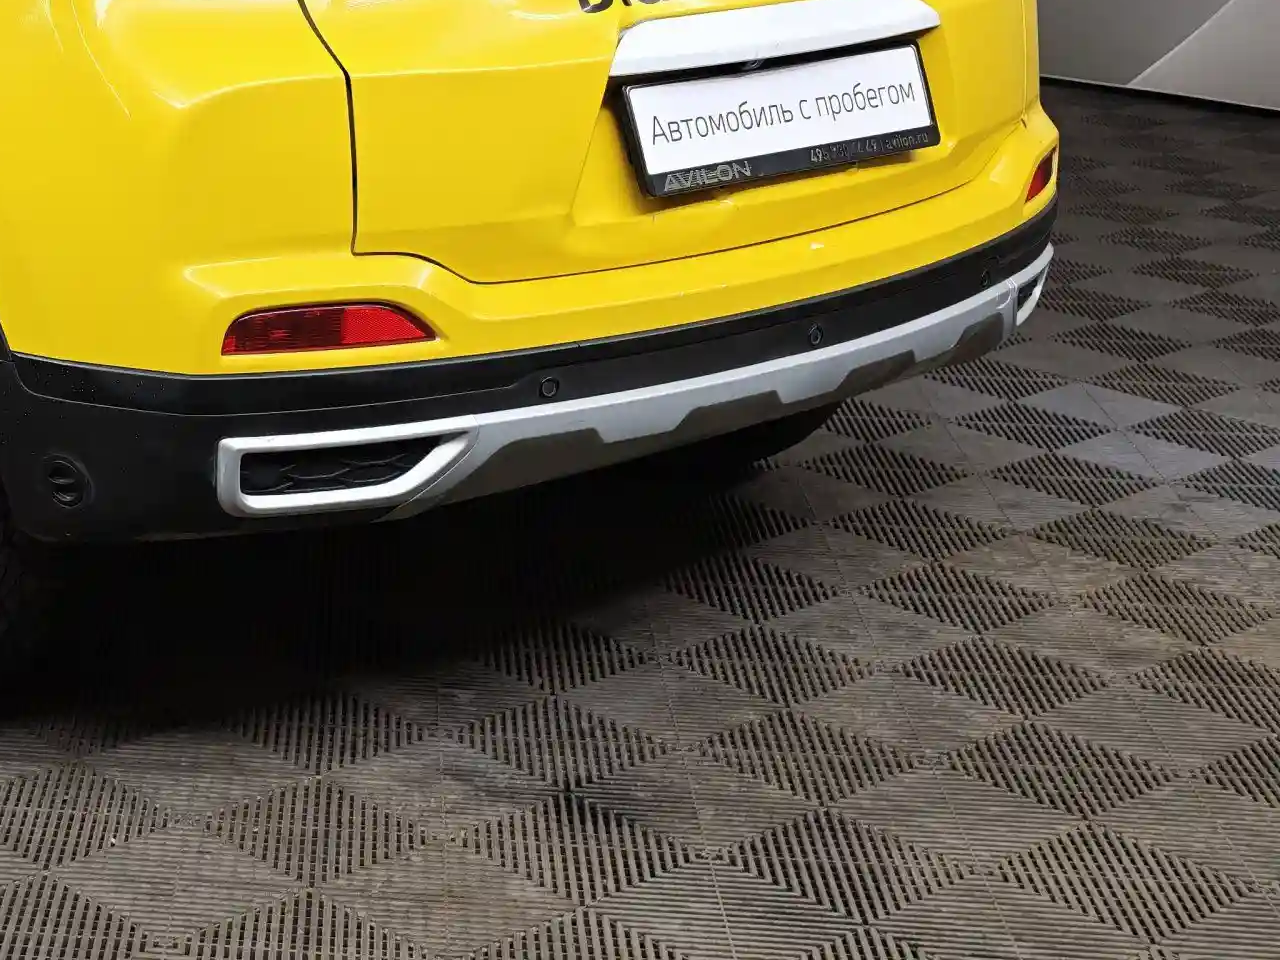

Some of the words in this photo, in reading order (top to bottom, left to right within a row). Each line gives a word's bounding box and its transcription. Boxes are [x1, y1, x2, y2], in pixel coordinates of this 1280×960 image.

[652, 100, 794, 146] Автомобиль
[798, 97, 813, 121] с
[816, 81, 916, 122] пробегом
[663, 160, 751, 192] AVILON
